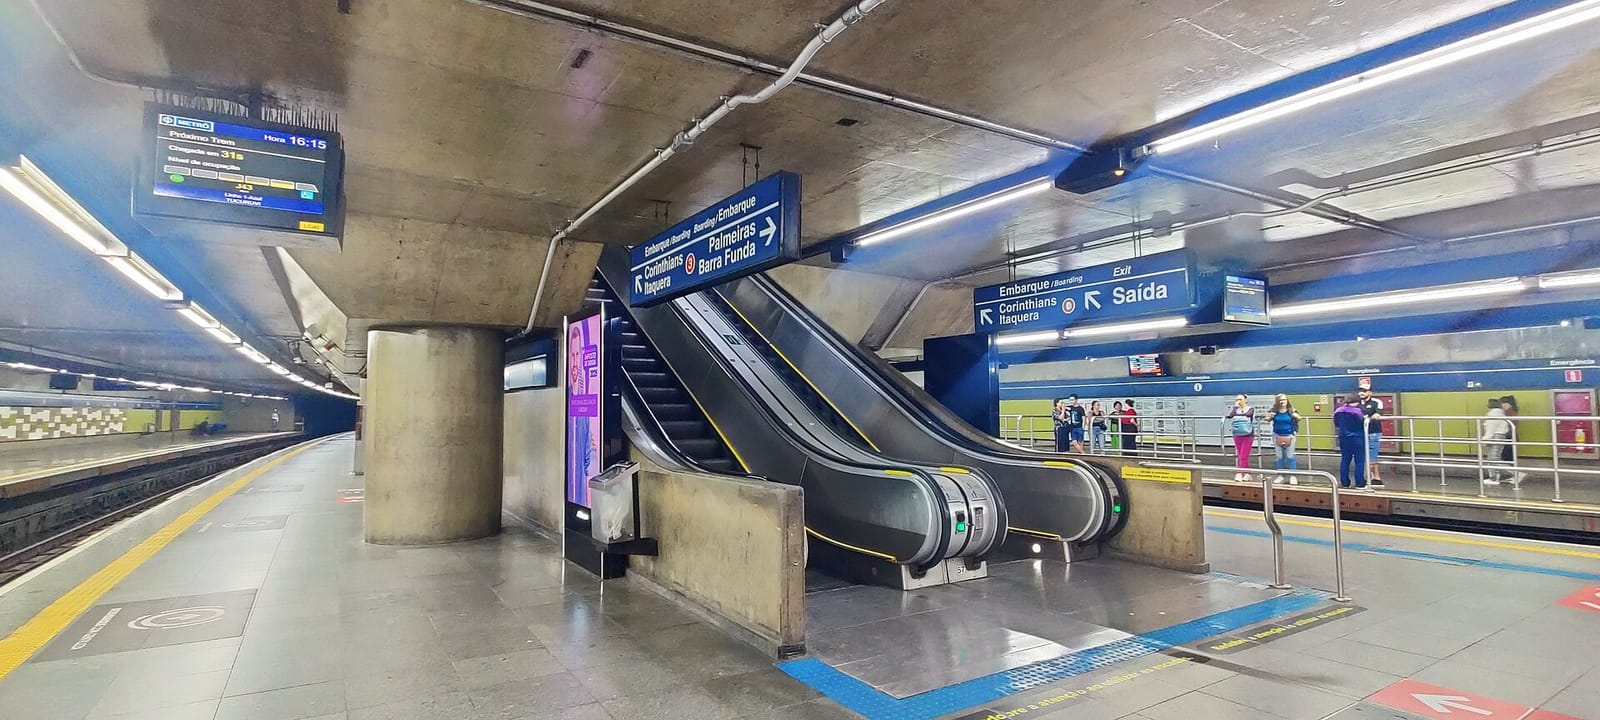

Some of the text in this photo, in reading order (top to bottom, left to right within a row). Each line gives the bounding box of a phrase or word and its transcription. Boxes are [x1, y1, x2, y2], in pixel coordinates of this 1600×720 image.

[169, 130, 236, 146] Próximo Trem
[264, 135, 327, 149] Hora 16:15
[168, 144, 205, 155] Chegada
[221, 150, 244, 161] 31s
[708, 222, 756, 254] Palmeiras
[644, 253, 684, 280] Corinthians
[698, 240, 756, 275] Barra Funda
[1113, 265, 1132, 277] Exit
[644, 275, 671, 296] Itaquera
[1112, 282, 1169, 306] Saída
[999, 296, 1057, 314] Corinthians
[999, 311, 1040, 326] Itaquera
[957, 565, 966, 574] 57
[1039, 689, 1087, 707] atenção
